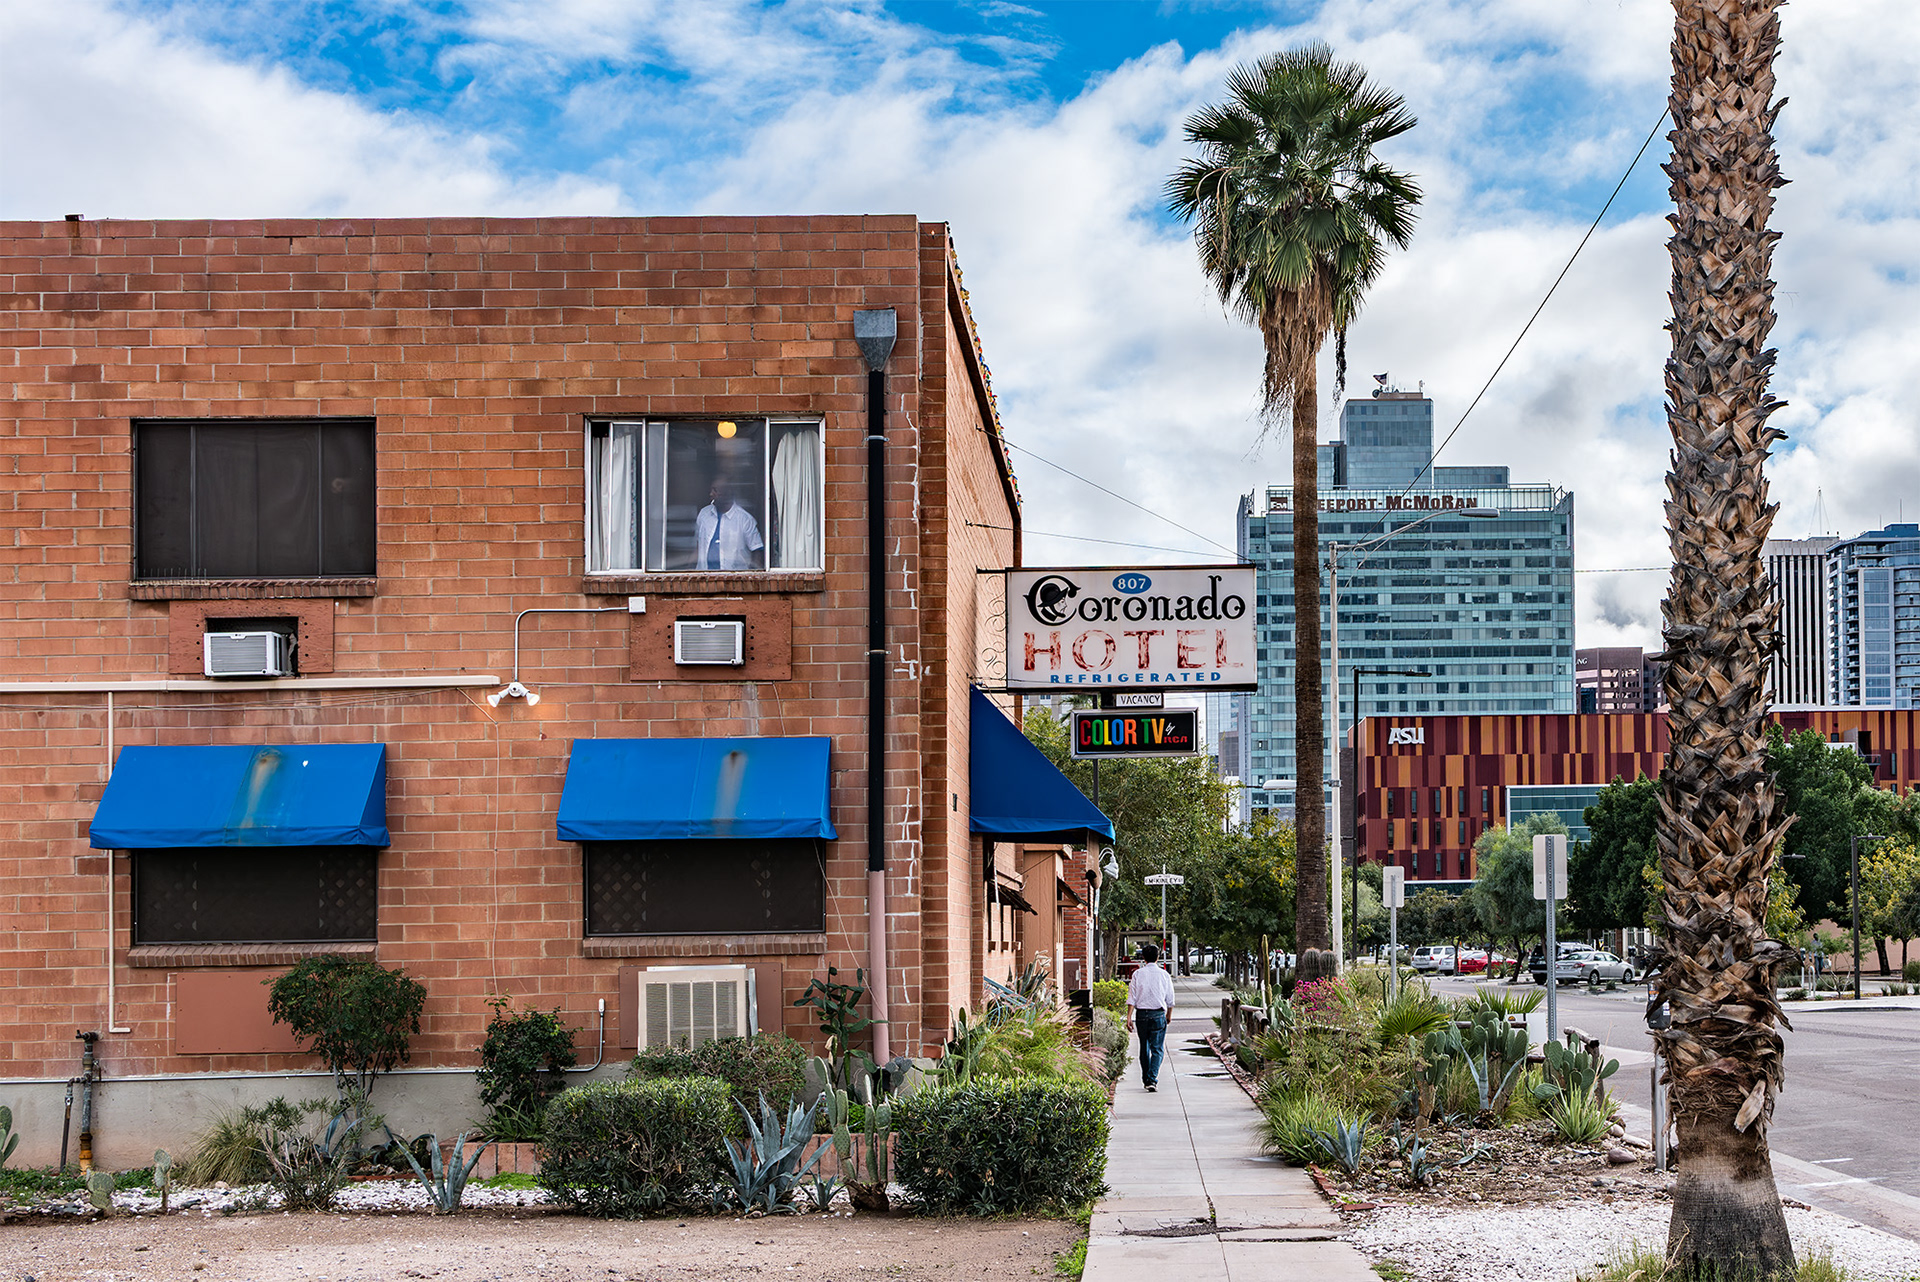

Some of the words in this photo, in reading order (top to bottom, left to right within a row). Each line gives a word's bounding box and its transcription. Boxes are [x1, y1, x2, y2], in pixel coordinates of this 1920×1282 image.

[1317, 498, 1383, 511] EEPORT-
[1117, 578, 1147, 590] 807
[1023, 574, 1246, 626] Coronado
[1024, 629, 1244, 672] HOTEL
[1050, 672, 1222, 684] REFRIGERATED
[1120, 695, 1161, 705] VACANCY
[1080, 718, 1137, 746] COLOR
[1141, 718, 1165, 744] TV
[1388, 727, 1426, 745] ASU
[1163, 735, 1188, 744] RCA
